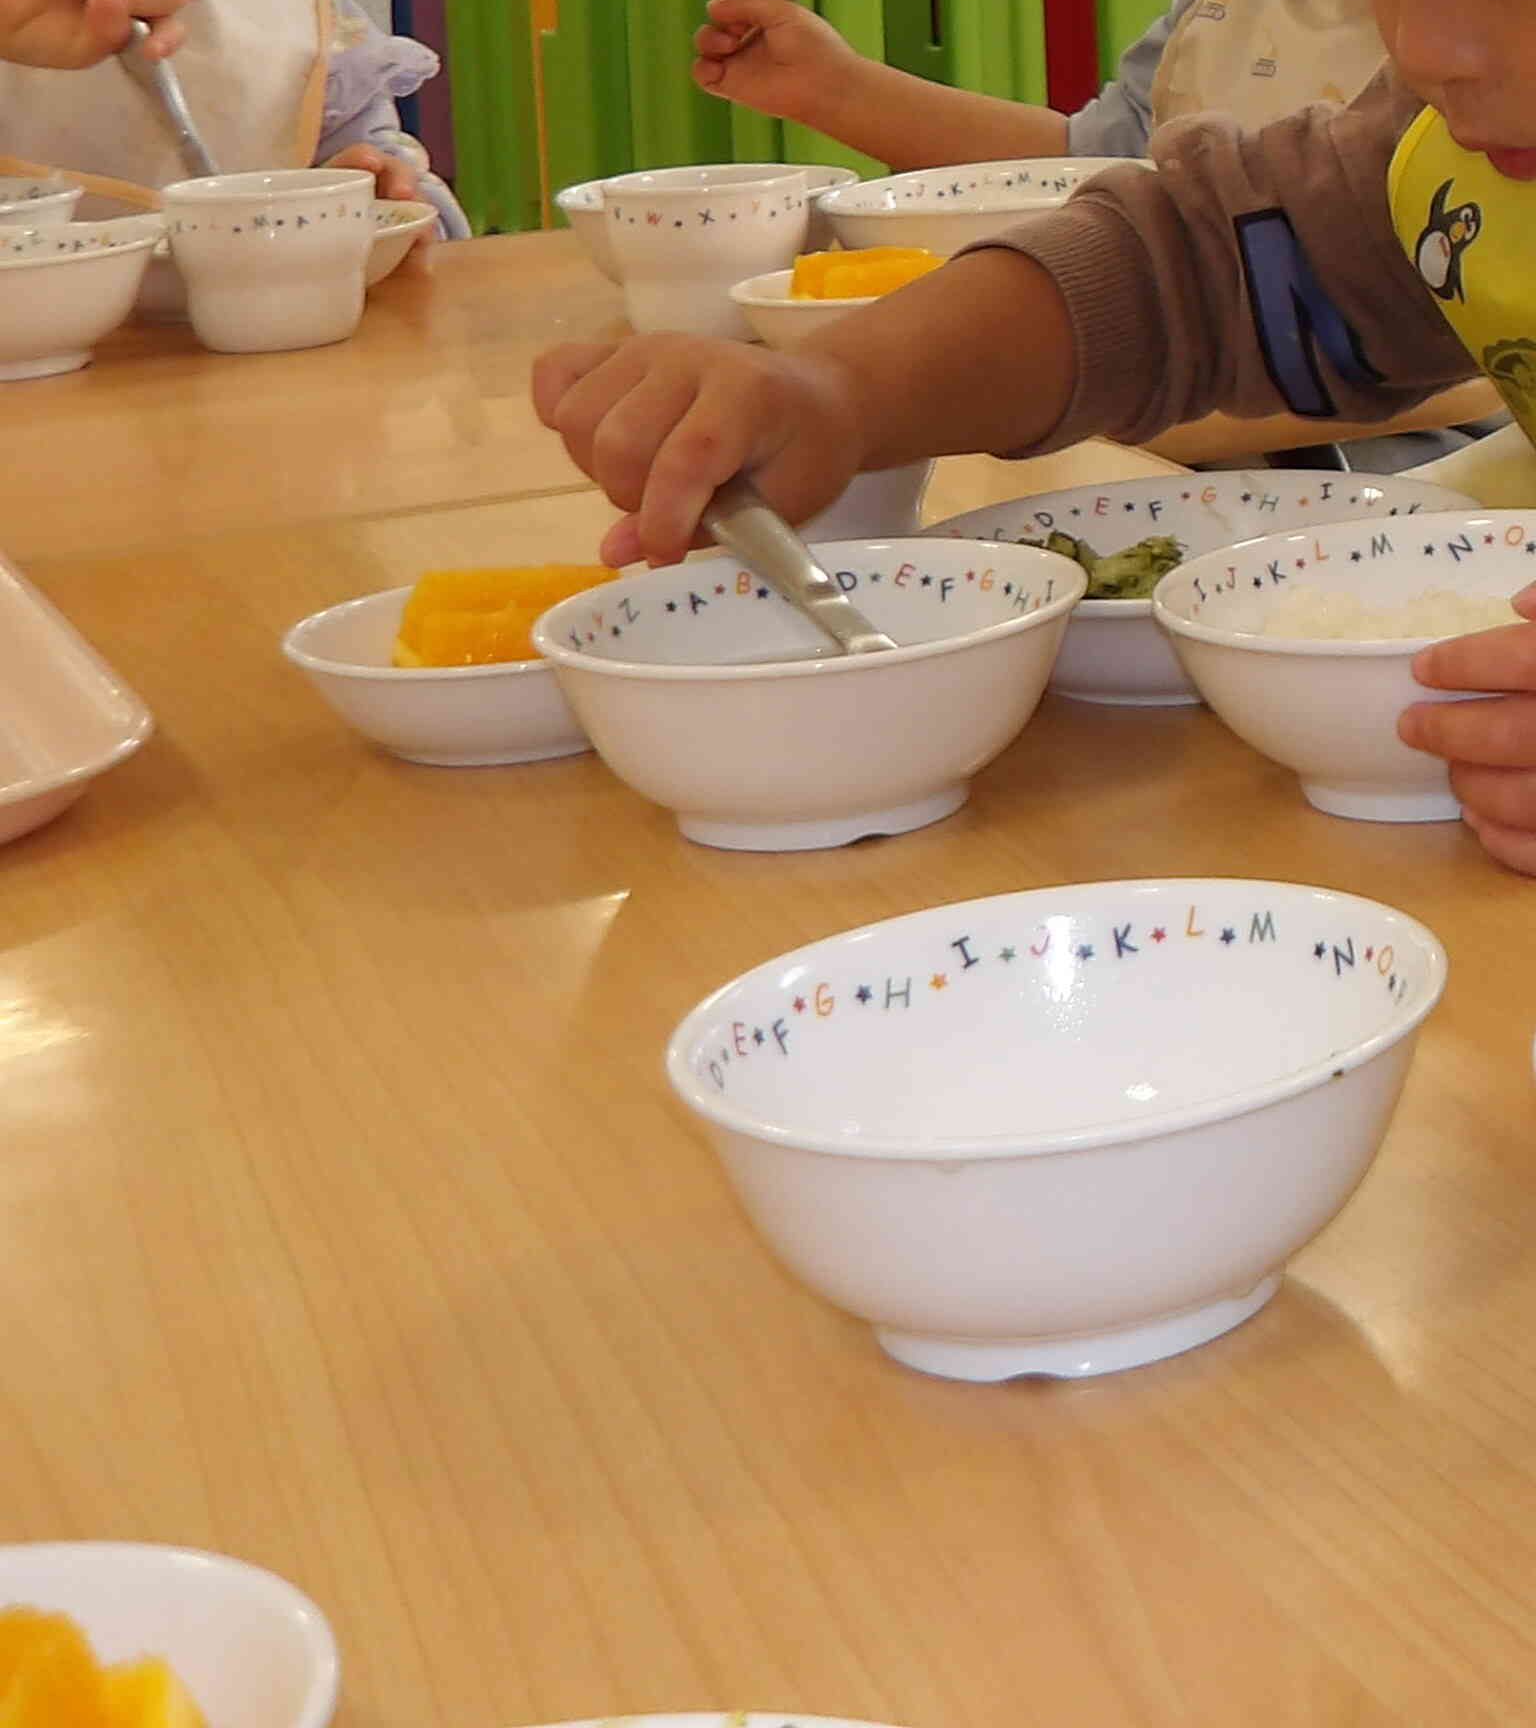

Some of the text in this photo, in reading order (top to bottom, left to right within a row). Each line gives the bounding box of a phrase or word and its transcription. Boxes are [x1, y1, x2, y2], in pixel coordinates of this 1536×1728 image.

[1033, 511, 1055, 528] D
[1093, 496, 1111, 517] E
[1147, 500, 1164, 522] F
[1201, 485, 1217, 504] G
[1258, 494, 1280, 513] H
[1320, 481, 1334, 501] I
[1224, 566, 1237, 590] J
[1267, 560, 1288, 585] K
[1315, 540, 1330, 561] L
[1370, 532, 1395, 558] M
[1447, 533, 1475, 562] N
[1504, 524, 1525, 546] O
[688, 591, 709, 616] A
[736, 570, 751, 596] B
[834, 571, 858, 592] D
[894, 562, 917, 587] E
[939, 576, 956, 604] F
[978, 567, 996, 592] G
[1011, 589, 1031, 611] H
[732, 1021, 748, 1056] E
[771, 1018, 790, 1056] F
[814, 982, 835, 1017] G
[883, 976, 912, 1010] H
[951, 934, 980, 970] I
[1112, 922, 1140, 959] K
[1185, 904, 1206, 937] L
[1248, 910, 1276, 944] M
[1332, 935, 1356, 977] N
[1376, 944, 1395, 977] O
